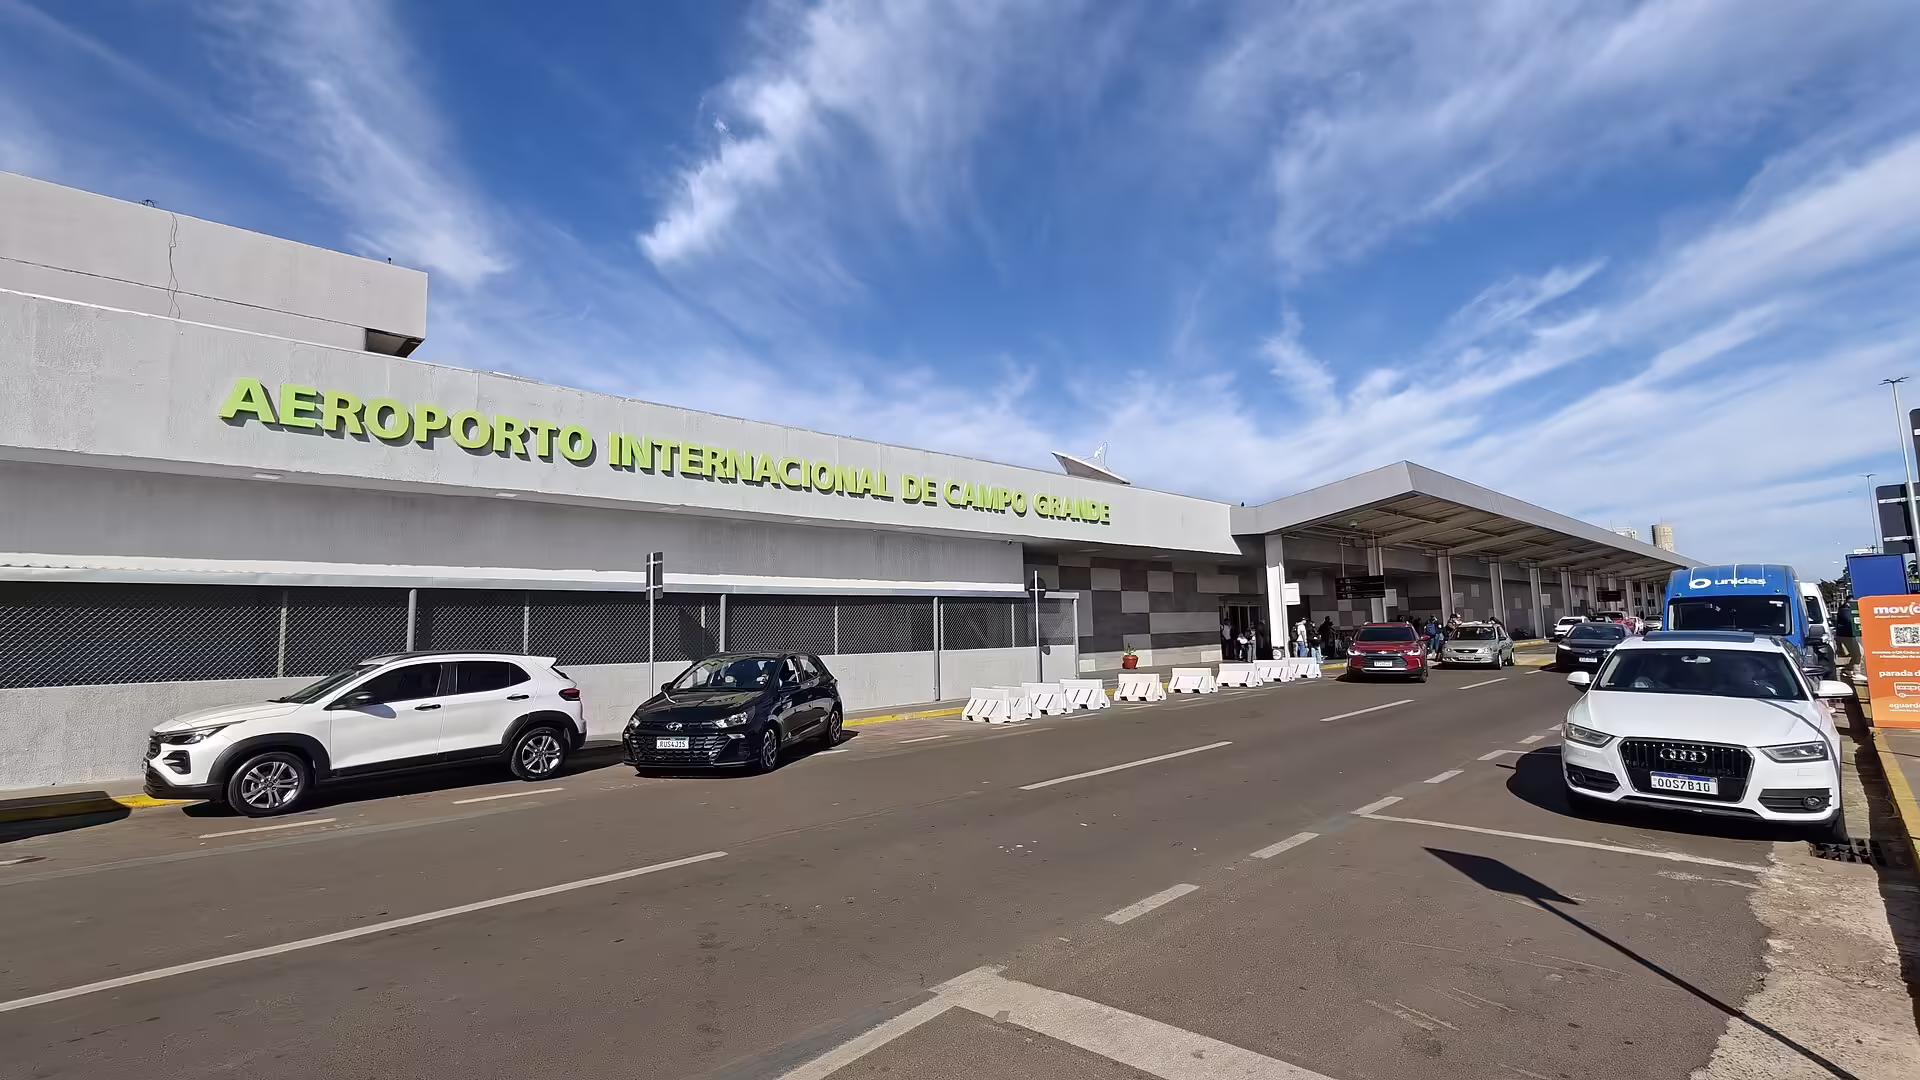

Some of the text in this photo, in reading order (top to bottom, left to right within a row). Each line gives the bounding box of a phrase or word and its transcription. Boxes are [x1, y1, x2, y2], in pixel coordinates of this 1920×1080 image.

[219, 377, 1111, 523] AEROPORTO INTERNACIONAL DE CAMPO GRANDE
[1714, 577, 1766, 585] unidas
[1879, 670, 1913, 678] parada
